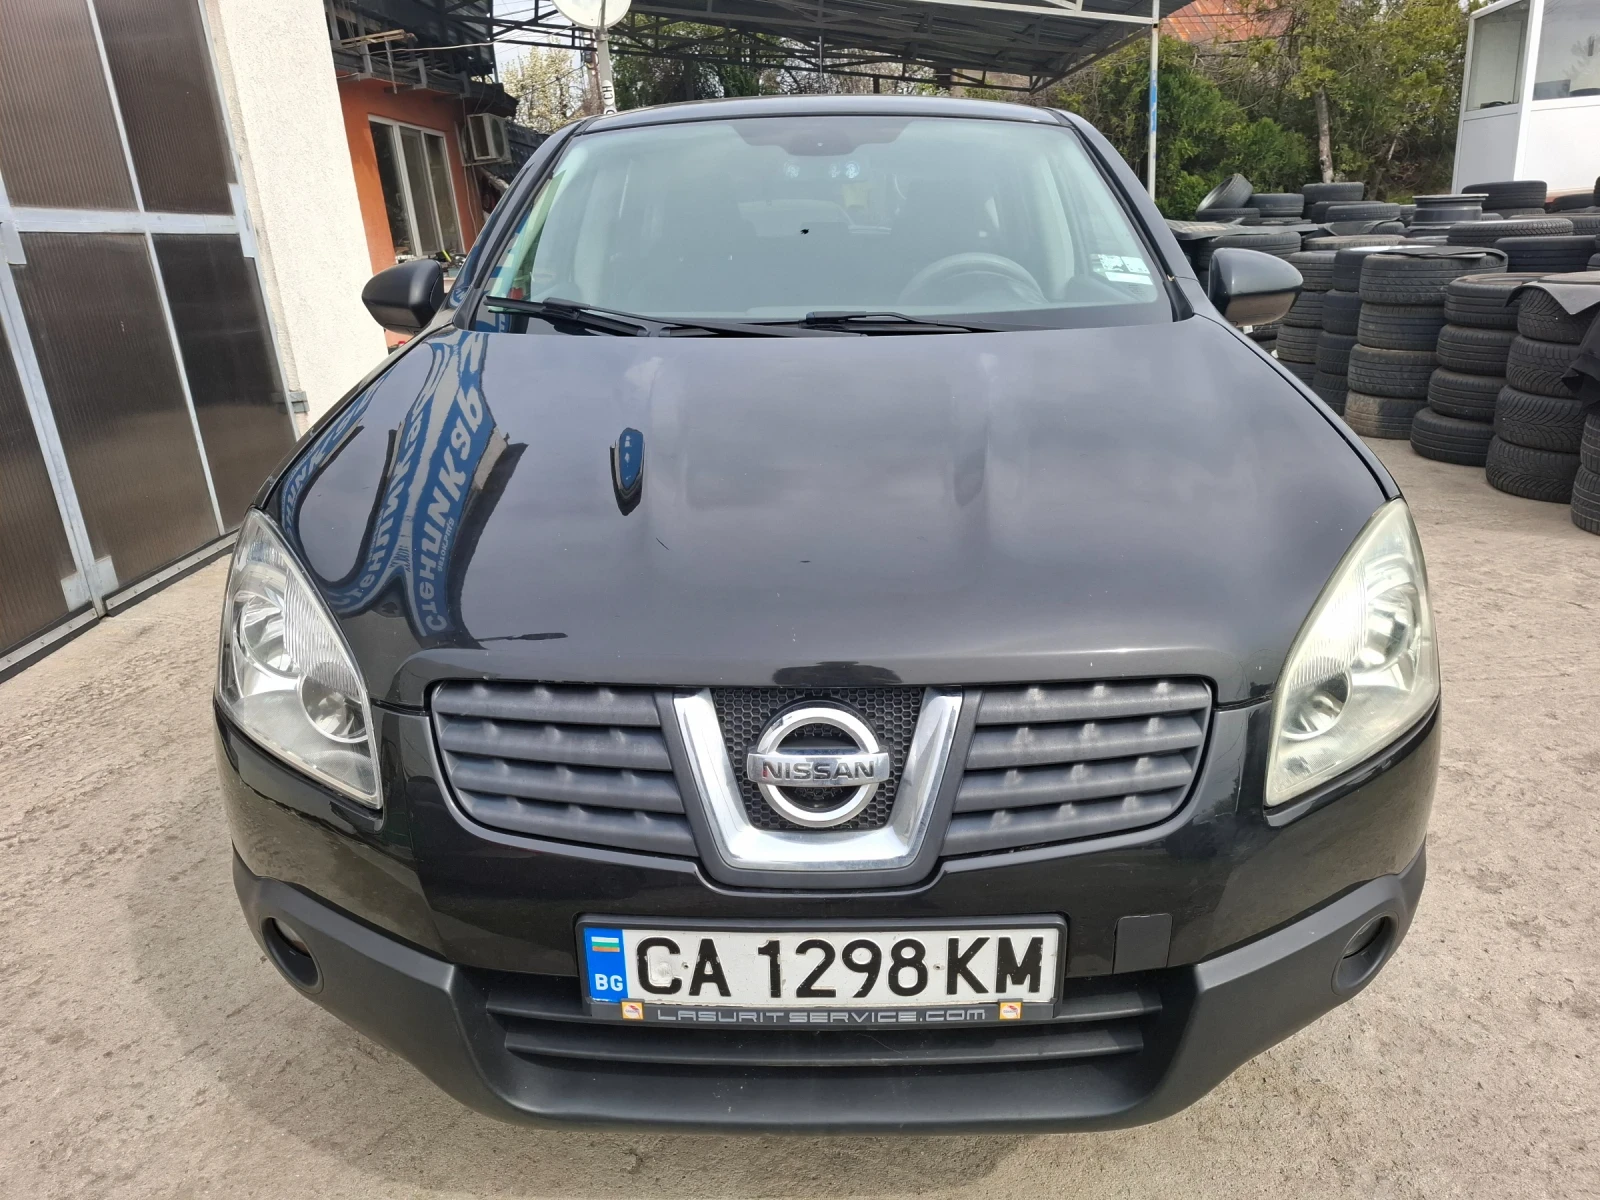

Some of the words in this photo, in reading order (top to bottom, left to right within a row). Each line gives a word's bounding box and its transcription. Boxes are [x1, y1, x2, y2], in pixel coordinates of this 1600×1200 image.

[761, 760, 876, 780] NISSAN
[636, 937, 732, 997] CA
[757, 938, 929, 998] 1298
[946, 937, 1045, 995] KM
[594, 973, 624, 992] BG
